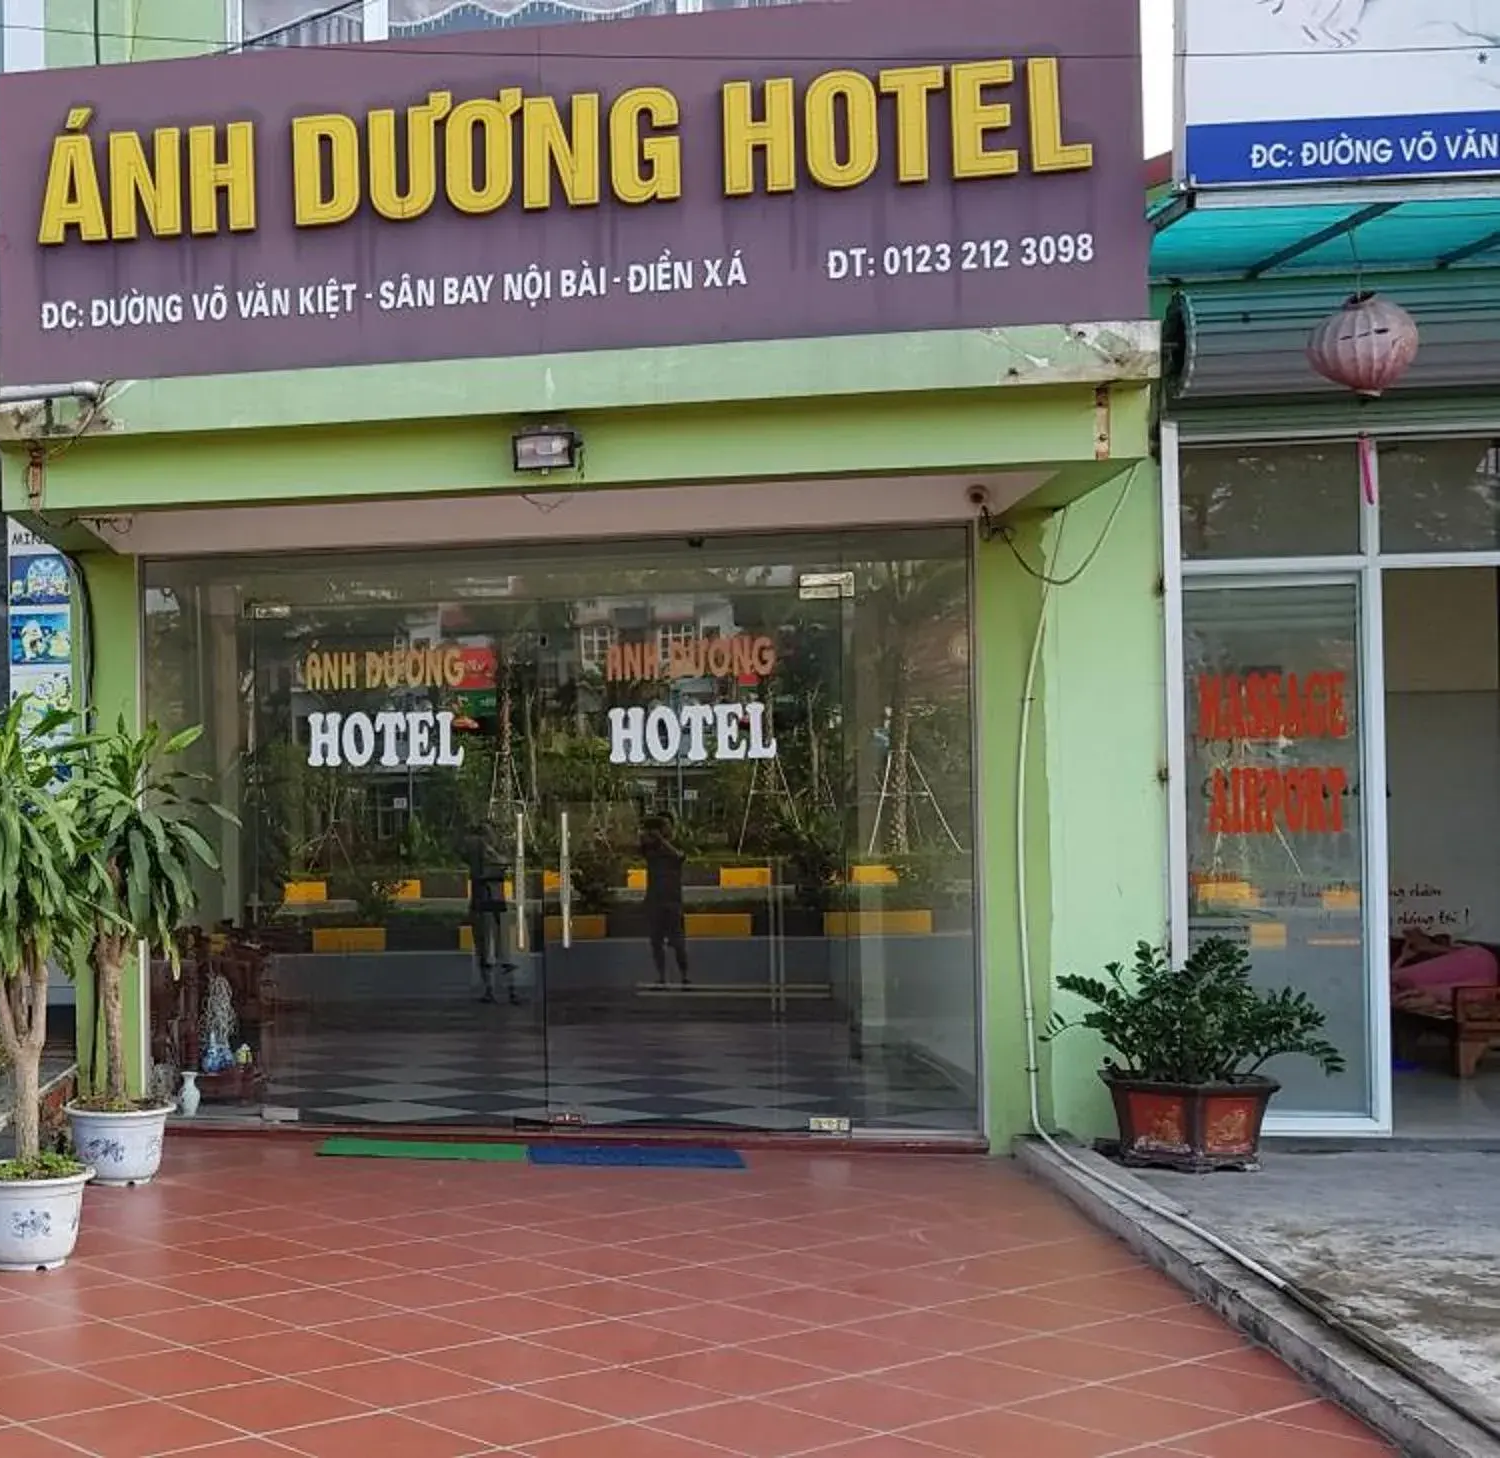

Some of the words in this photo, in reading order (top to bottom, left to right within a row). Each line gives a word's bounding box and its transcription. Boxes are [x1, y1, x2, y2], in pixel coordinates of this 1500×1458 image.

[38, 105, 256, 245] ÁNH
[292, 86, 681, 228] DƯƠNG
[723, 56, 1093, 197] HOTEL
[1251, 142, 1294, 169] ĐC:
[1301, 131, 1393, 167] ĐƯỜNG
[1400, 130, 1437, 162] VÕ
[1444, 128, 1499, 160] VĂN
[828, 248, 875, 280] ĐT:
[883, 243, 952, 275] 0123
[961, 239, 1010, 270] 212
[1020, 233, 1094, 266] 3098
[41, 302, 85, 330] ĐC:
[91, 287, 183, 328] ĐƯỜNG
[192, 285, 228, 321] VÕ
[237, 281, 290, 319] VĂN
[299, 277, 357, 321] KIỆT
[379, 272, 436, 310] SÂN
[443, 274, 494, 306] BAY
[503, 263, 552, 309] NỘI
[560, 259, 608, 299] BÀI
[627, 247, 694, 294] ĐIỀN
[305, 640, 357, 691] ÁNH
[609, 702, 777, 764] HOTEL
[1198, 671, 1348, 739] MASSAGE
[307, 711, 465, 768] HOTEL
[1207, 766, 1348, 834] AIRPORT
